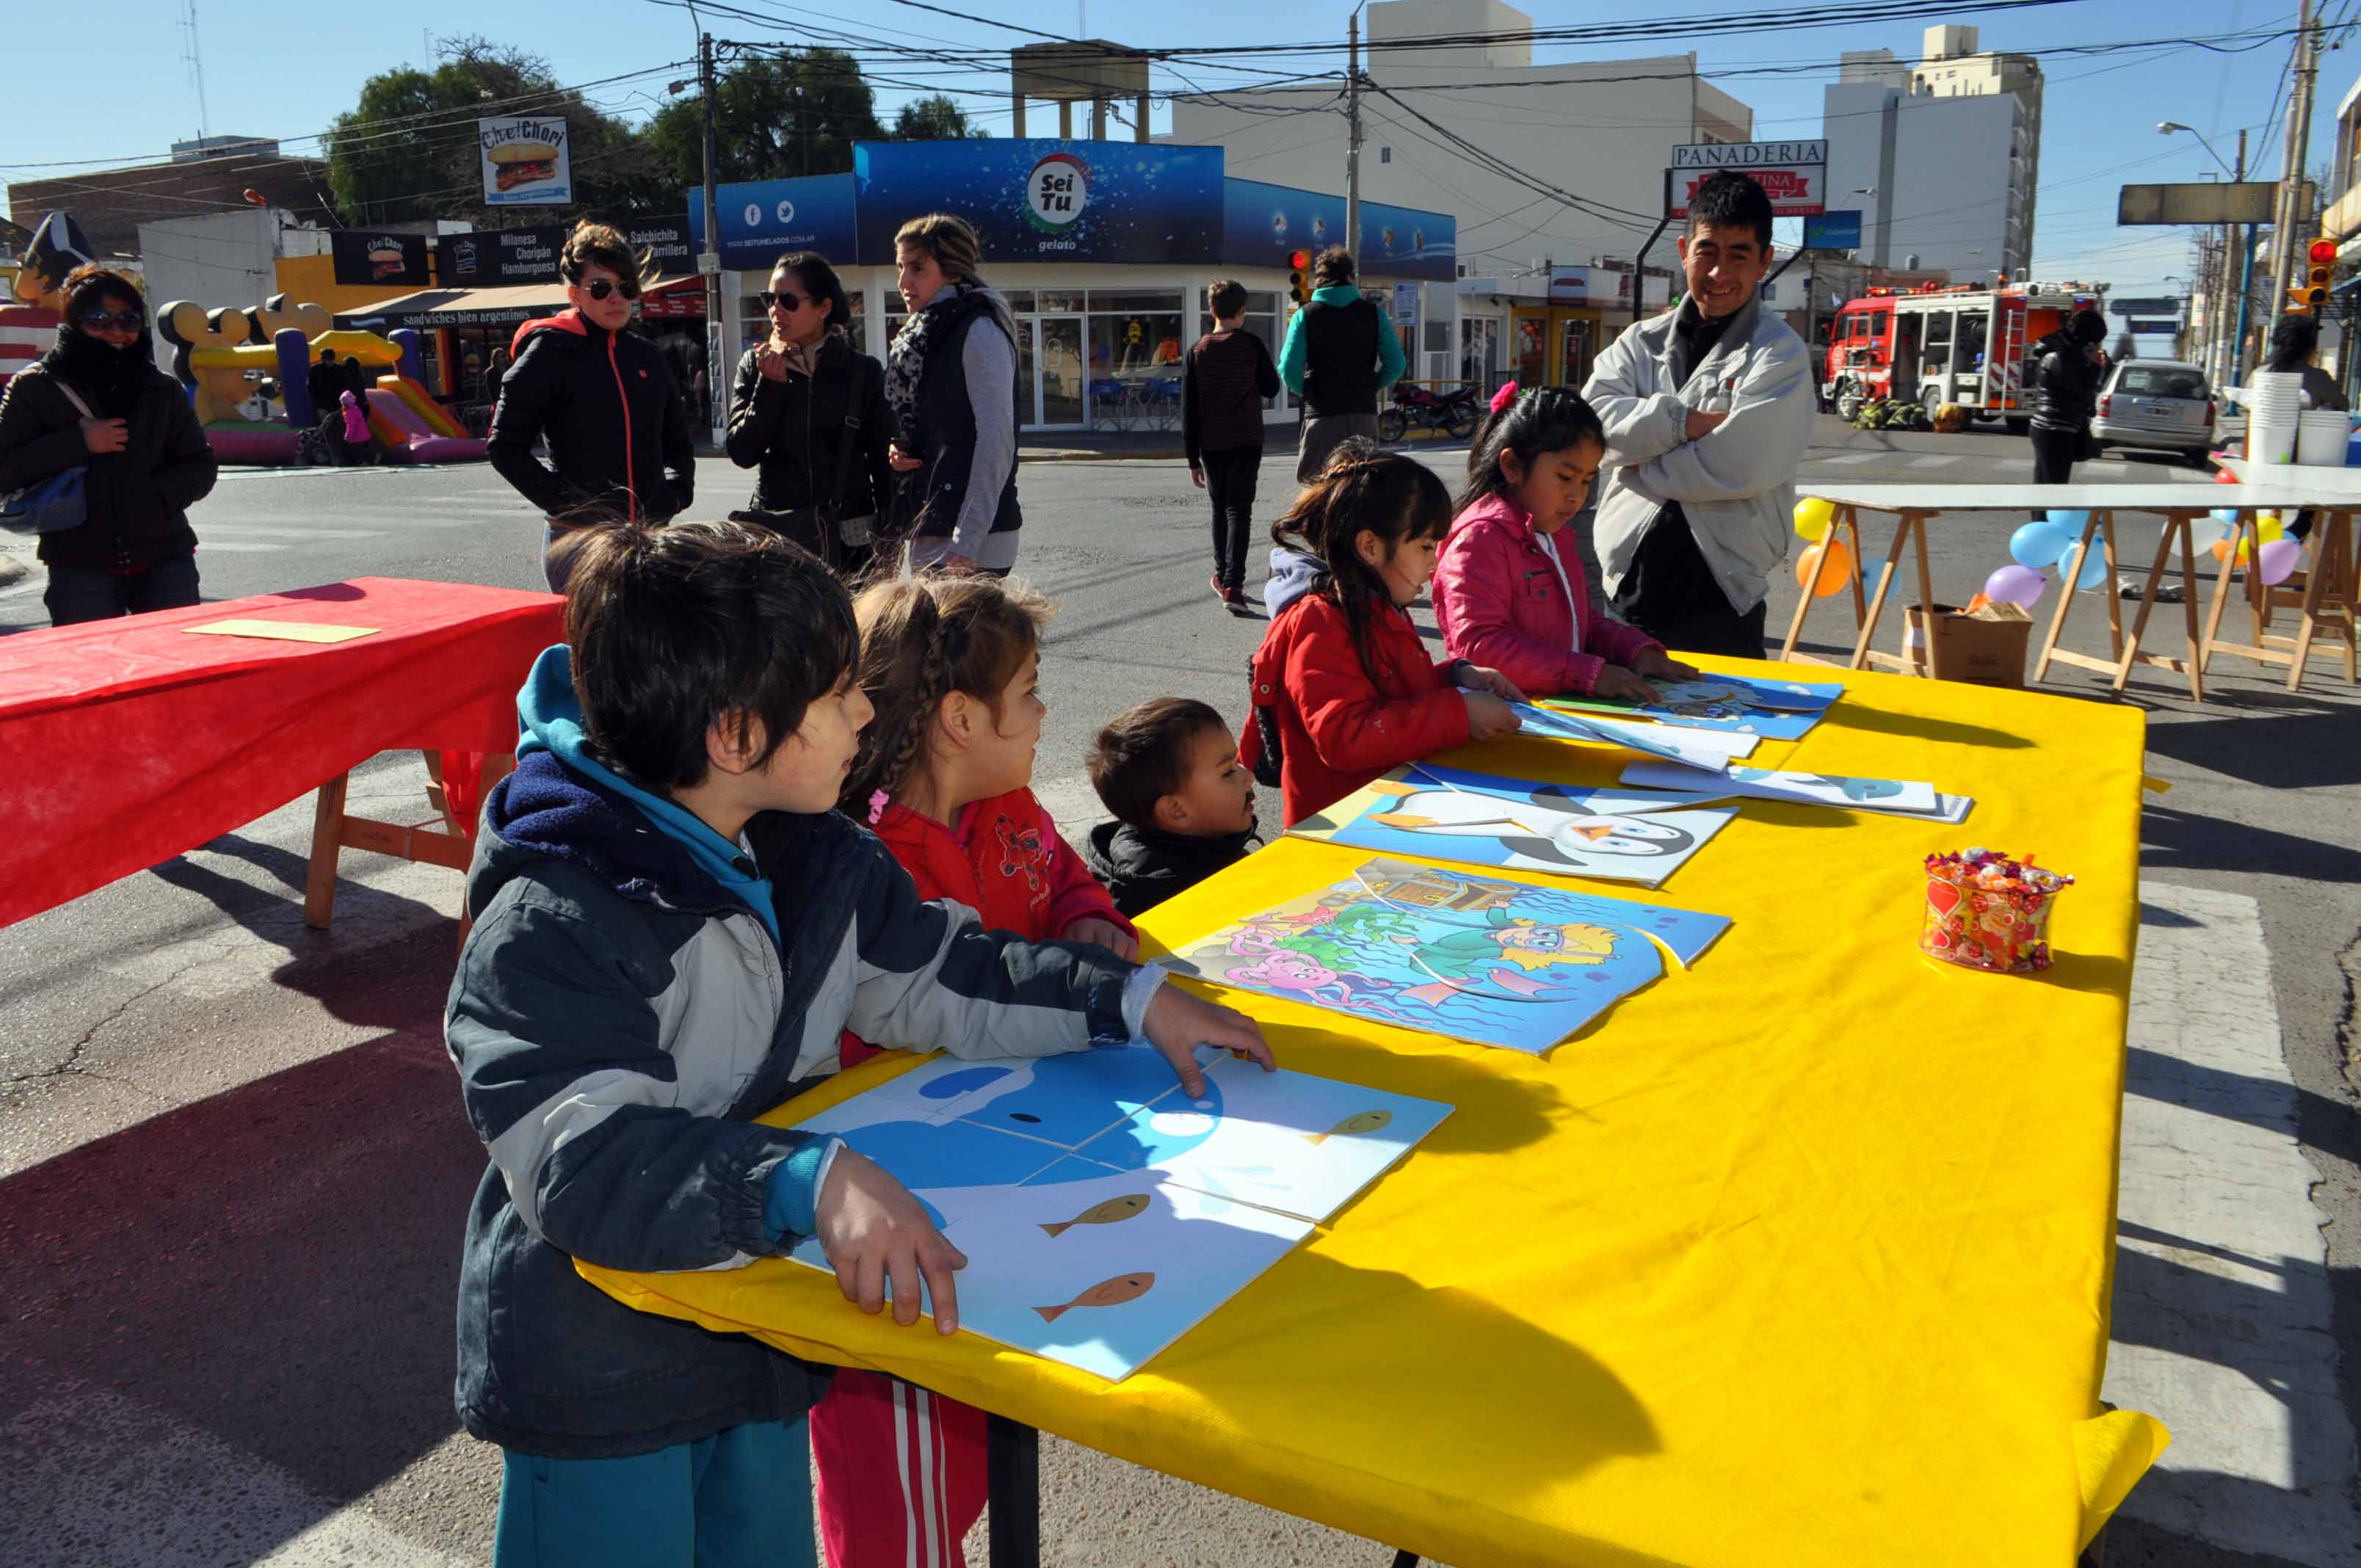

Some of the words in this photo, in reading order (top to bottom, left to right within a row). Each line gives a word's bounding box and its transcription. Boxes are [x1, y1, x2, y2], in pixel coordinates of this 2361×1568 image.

[1677, 144, 1821, 165] PANADERIA
[1041, 174, 1074, 192] Sei
[1040, 193, 1072, 211] Tu
[501, 234, 537, 247] Milanesa
[630, 228, 678, 244] Salchichita
[516, 246, 552, 261] Choripán
[1039, 239, 1076, 253] gelato
[501, 261, 556, 276] Hamburguesa
[404, 312, 456, 325] sandwiches
[457, 311, 478, 323] bien
[479, 308, 531, 324] argentinos
